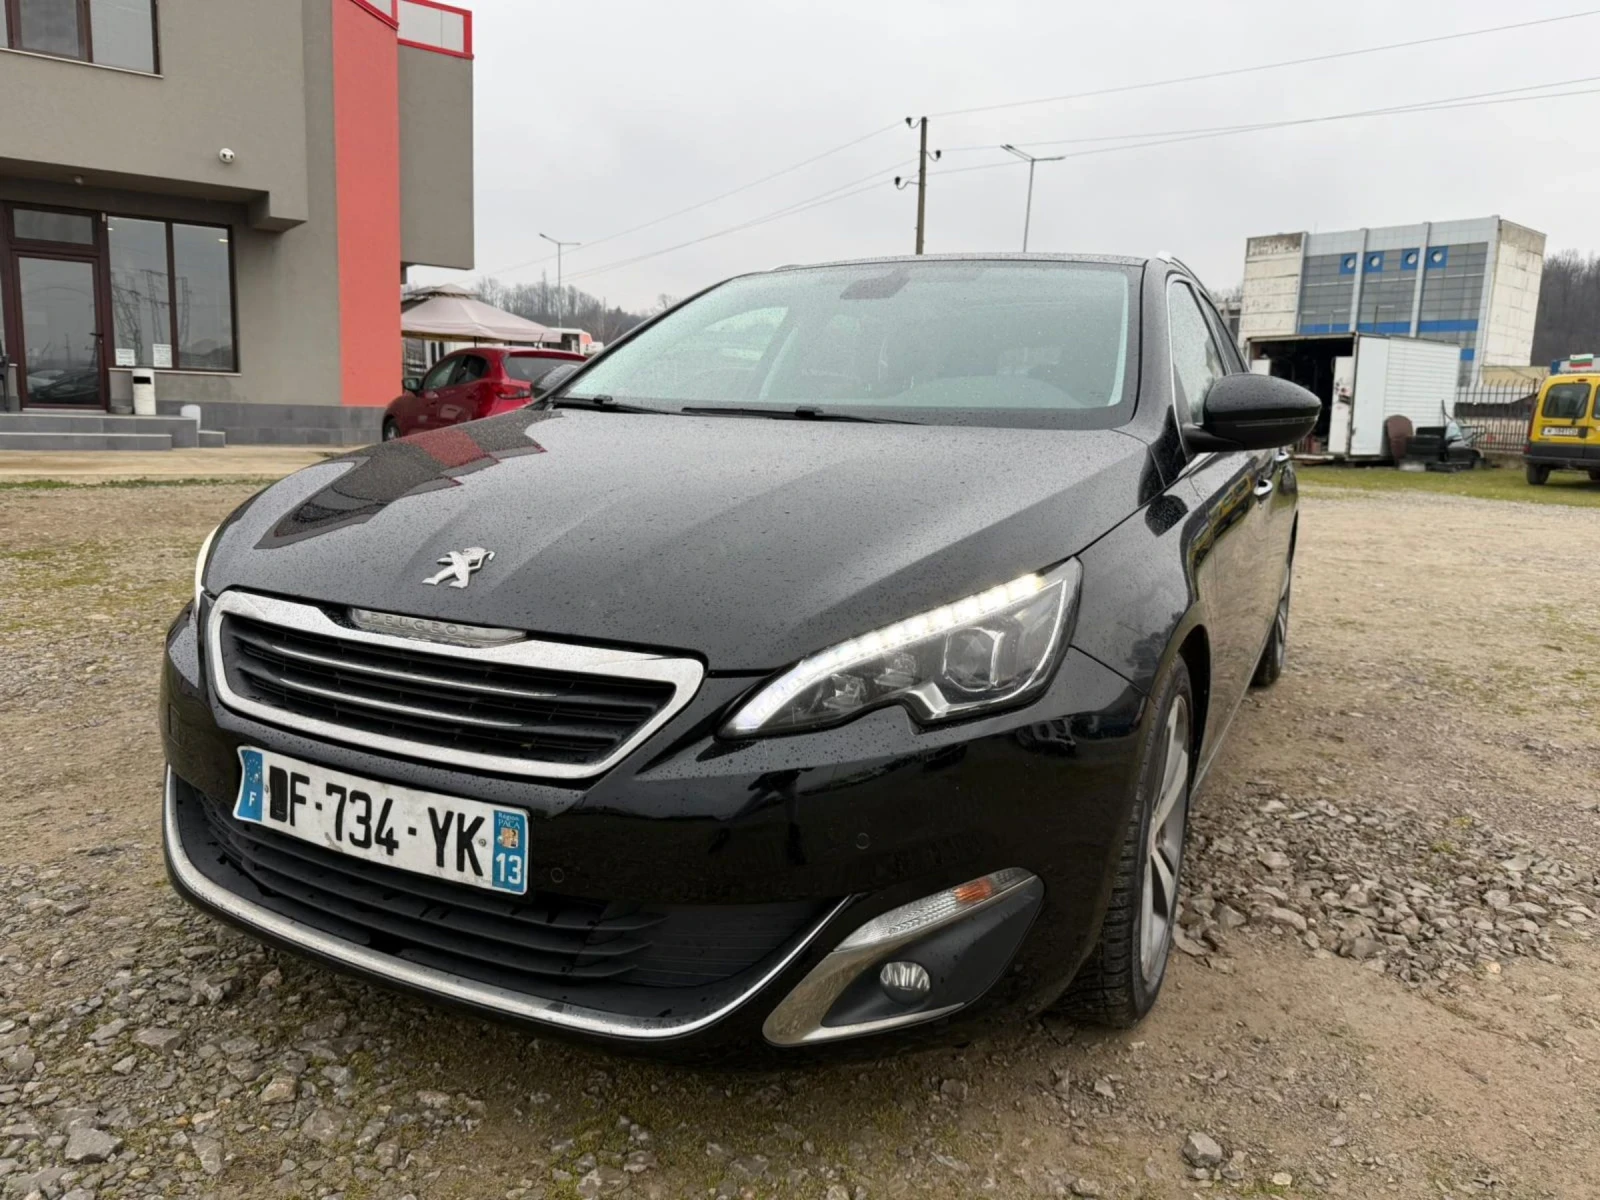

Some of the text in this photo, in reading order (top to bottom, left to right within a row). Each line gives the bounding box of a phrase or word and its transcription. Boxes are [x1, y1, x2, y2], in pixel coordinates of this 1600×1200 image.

[370, 612, 475, 638] PEUGEOT
[248, 791, 257, 807] F
[269, 765, 485, 877] F-734-YK
[498, 819, 520, 830] PACA
[496, 852, 522, 885] 13
